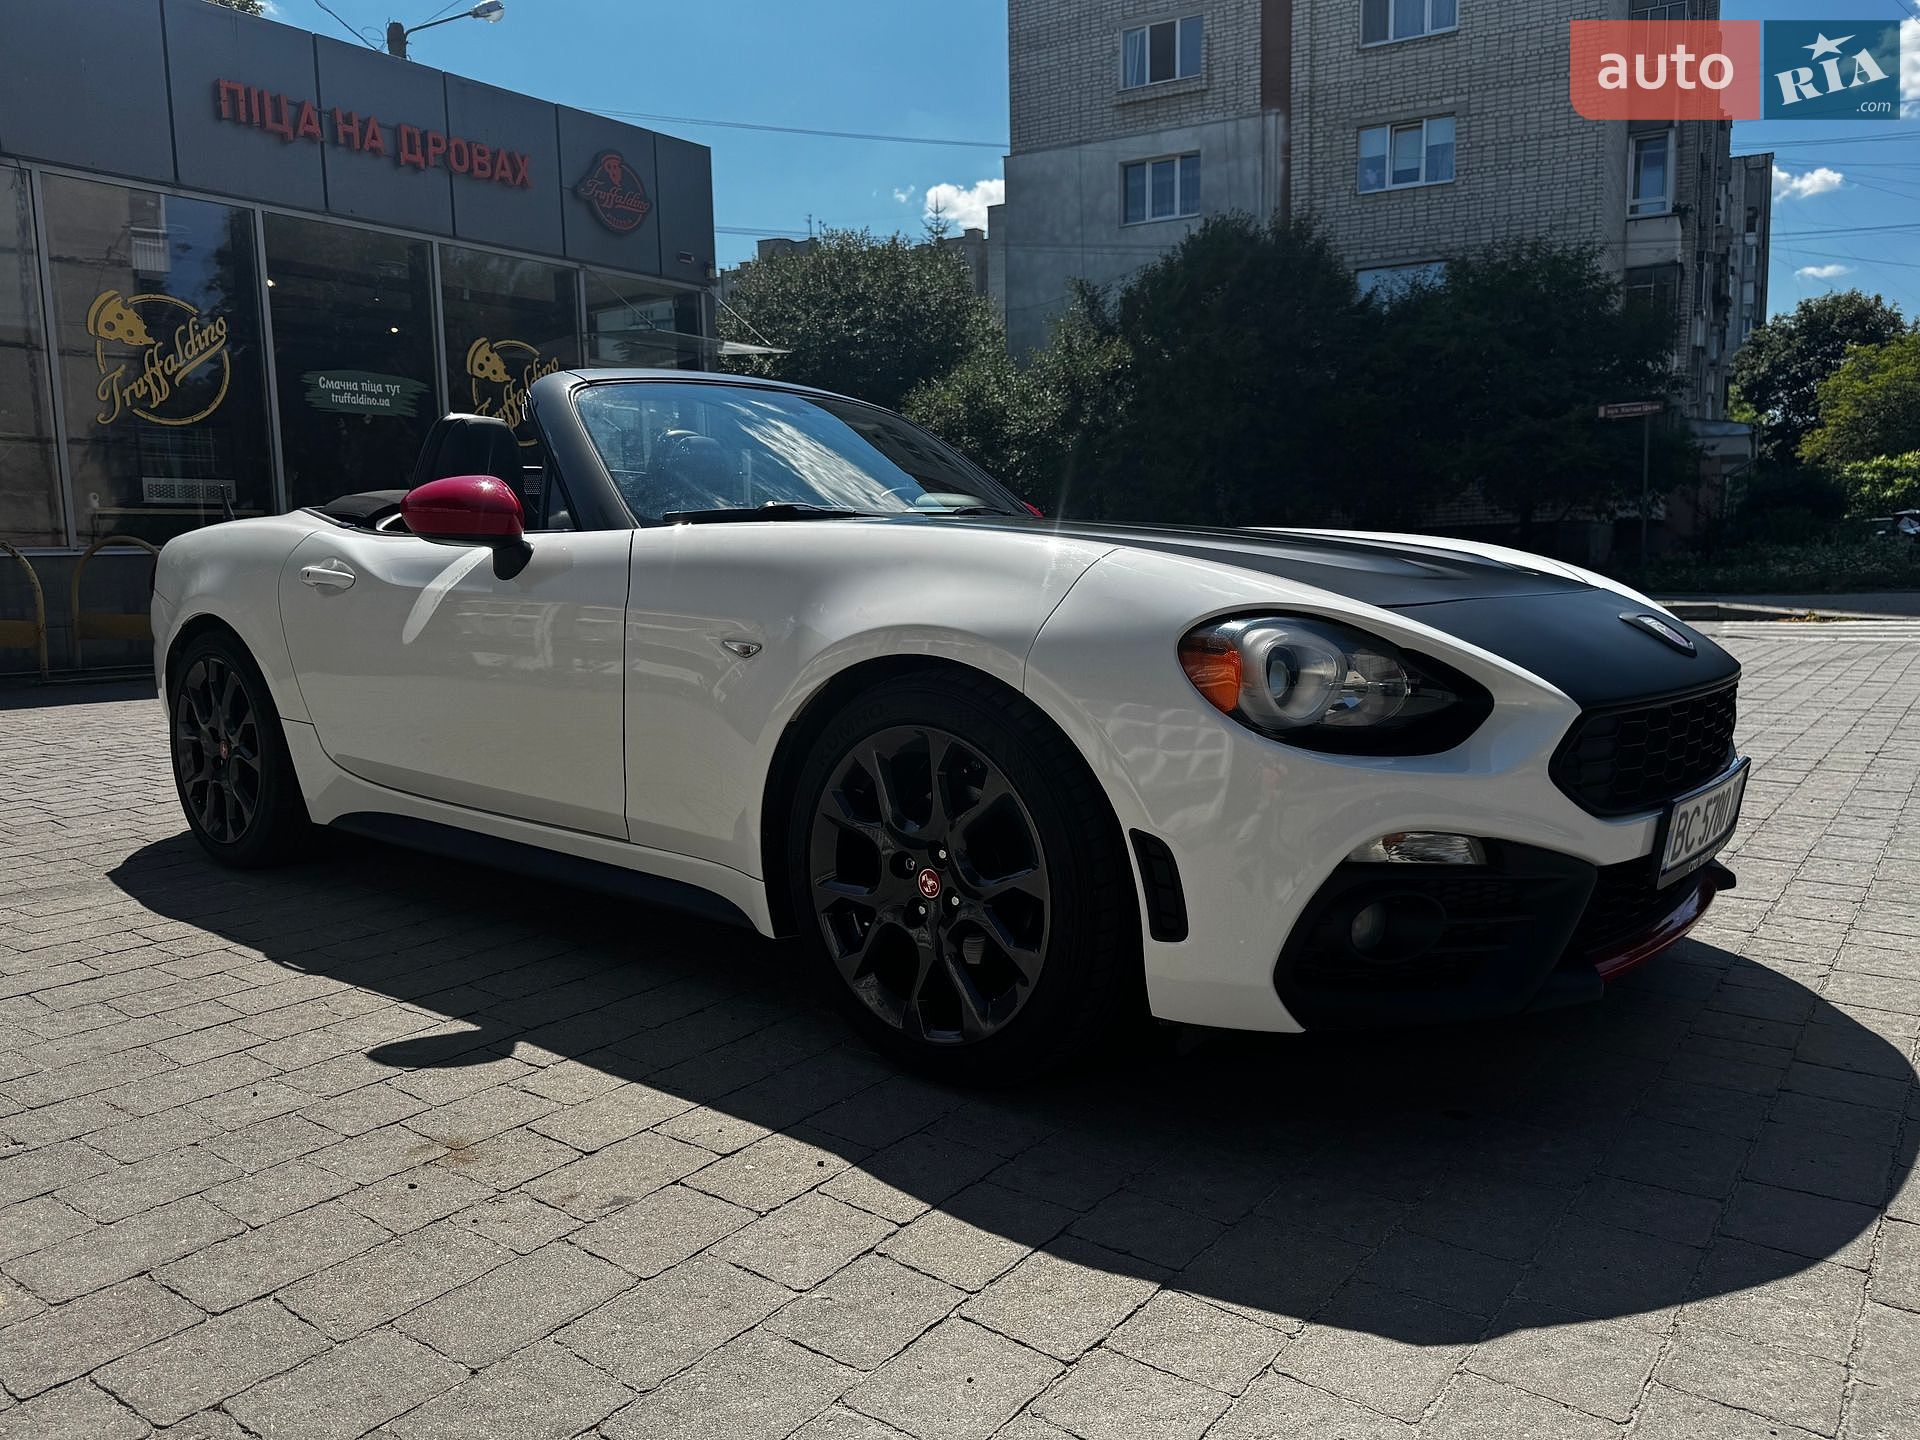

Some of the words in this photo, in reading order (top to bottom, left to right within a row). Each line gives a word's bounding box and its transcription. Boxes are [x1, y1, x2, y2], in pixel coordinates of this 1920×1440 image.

[216, 78, 322, 143] ПІЦА
[332, 106, 387, 156] НА
[396, 122, 533, 188] ДРОВАХ
[96, 315, 228, 424] Truffaldino
[319, 376, 359, 391] Смачна
[360, 380, 383, 394] піца
[384, 384, 401, 396] тут
[331, 393, 391, 407] truffaldino.ua
